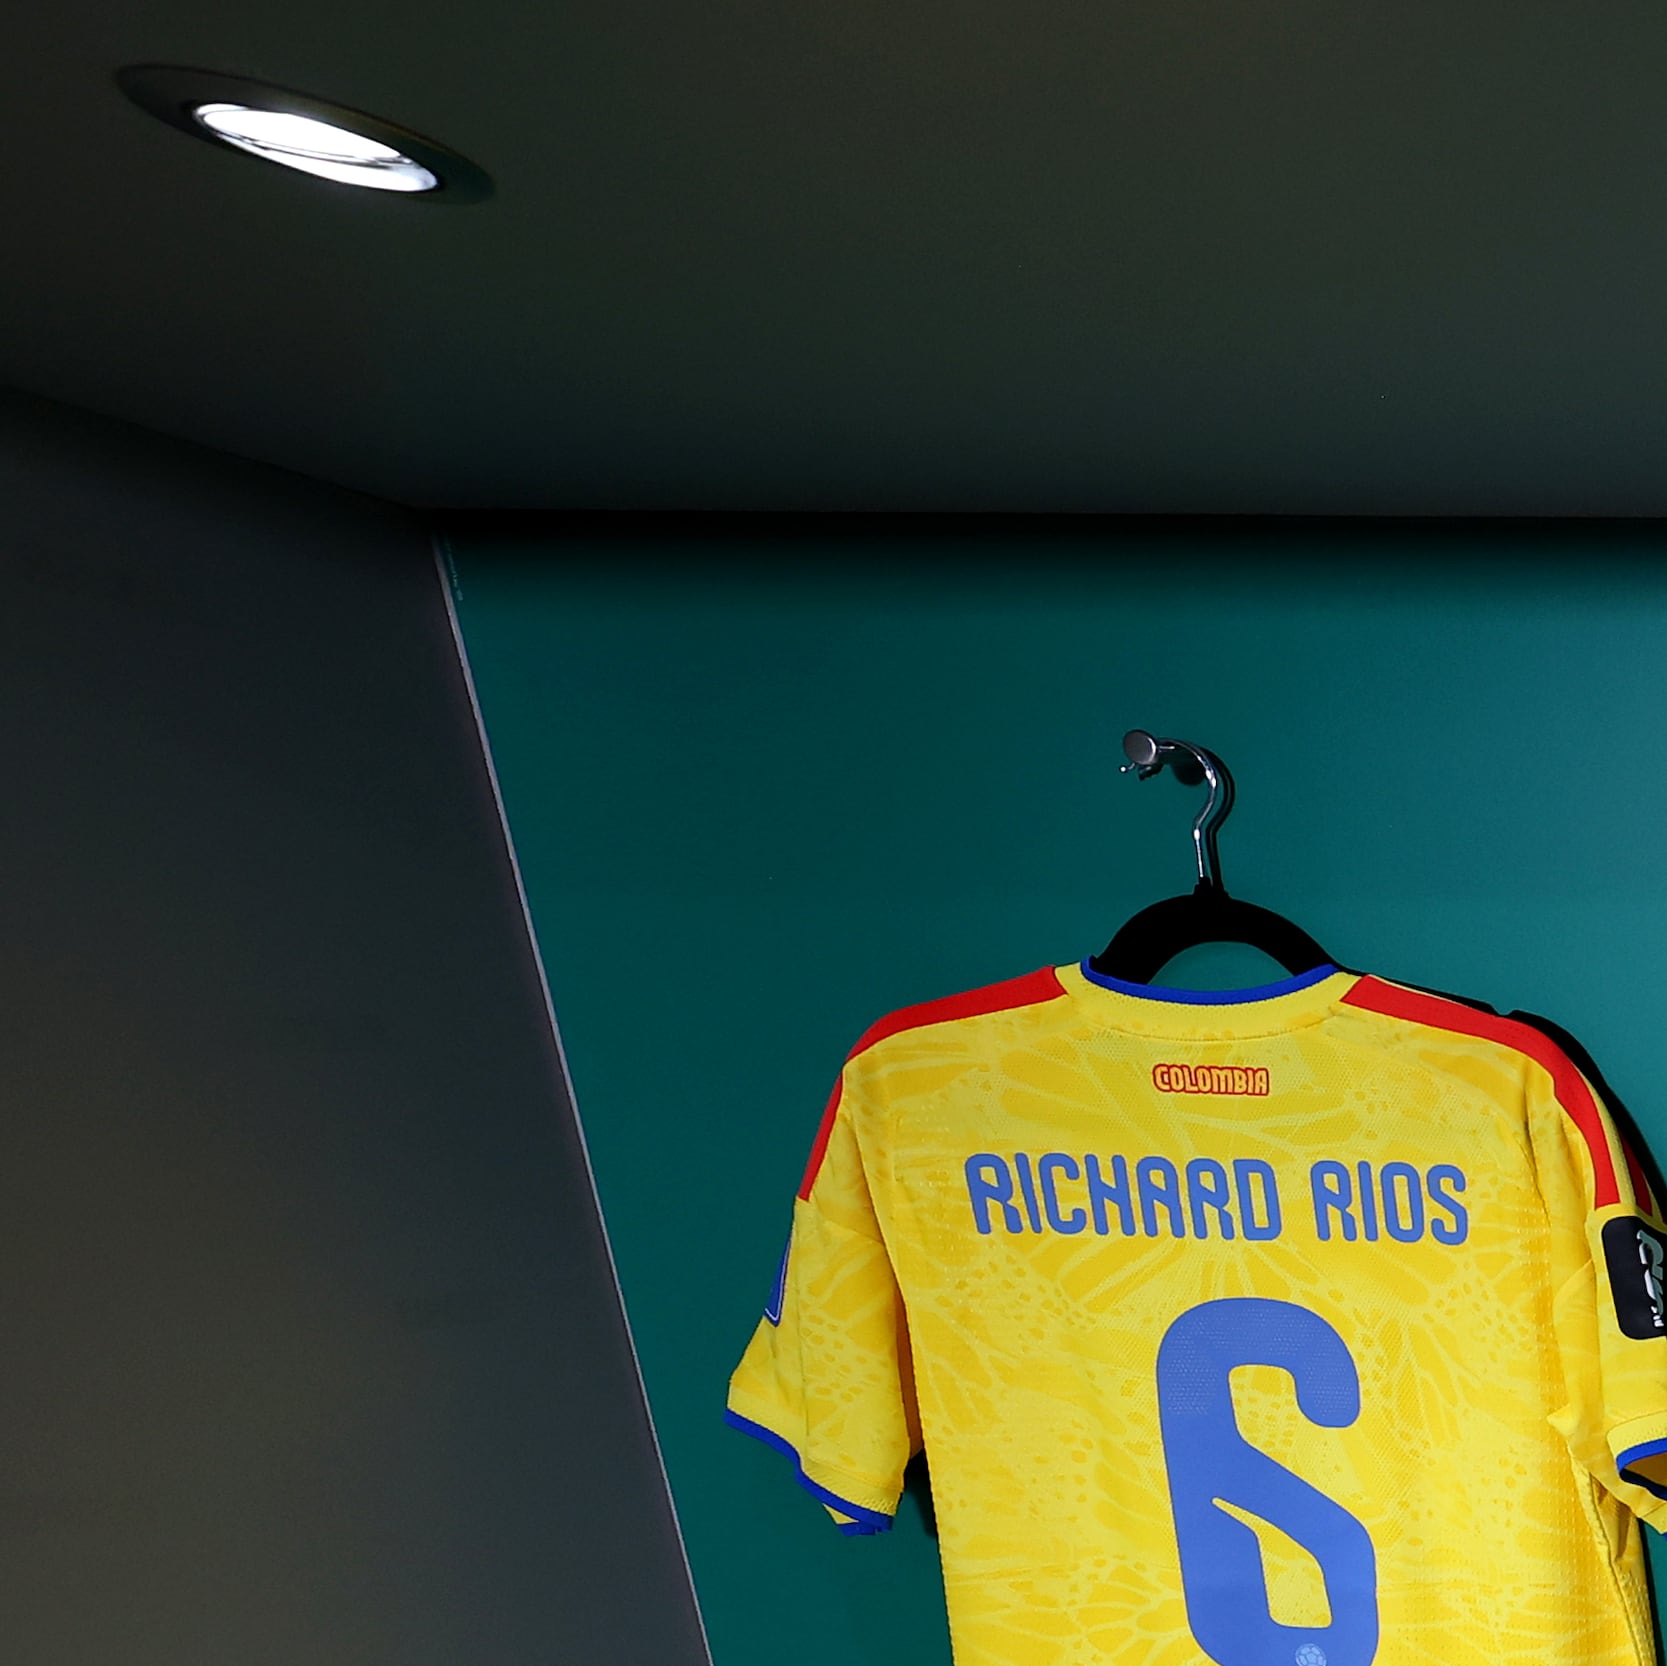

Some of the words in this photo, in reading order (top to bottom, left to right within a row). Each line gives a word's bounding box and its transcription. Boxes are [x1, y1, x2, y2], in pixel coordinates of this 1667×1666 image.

[1153, 1063, 1269, 1096] COLOMBIA
[965, 1153, 1281, 1241] RICHARD
[1310, 1160, 1468, 1245] RIOS
